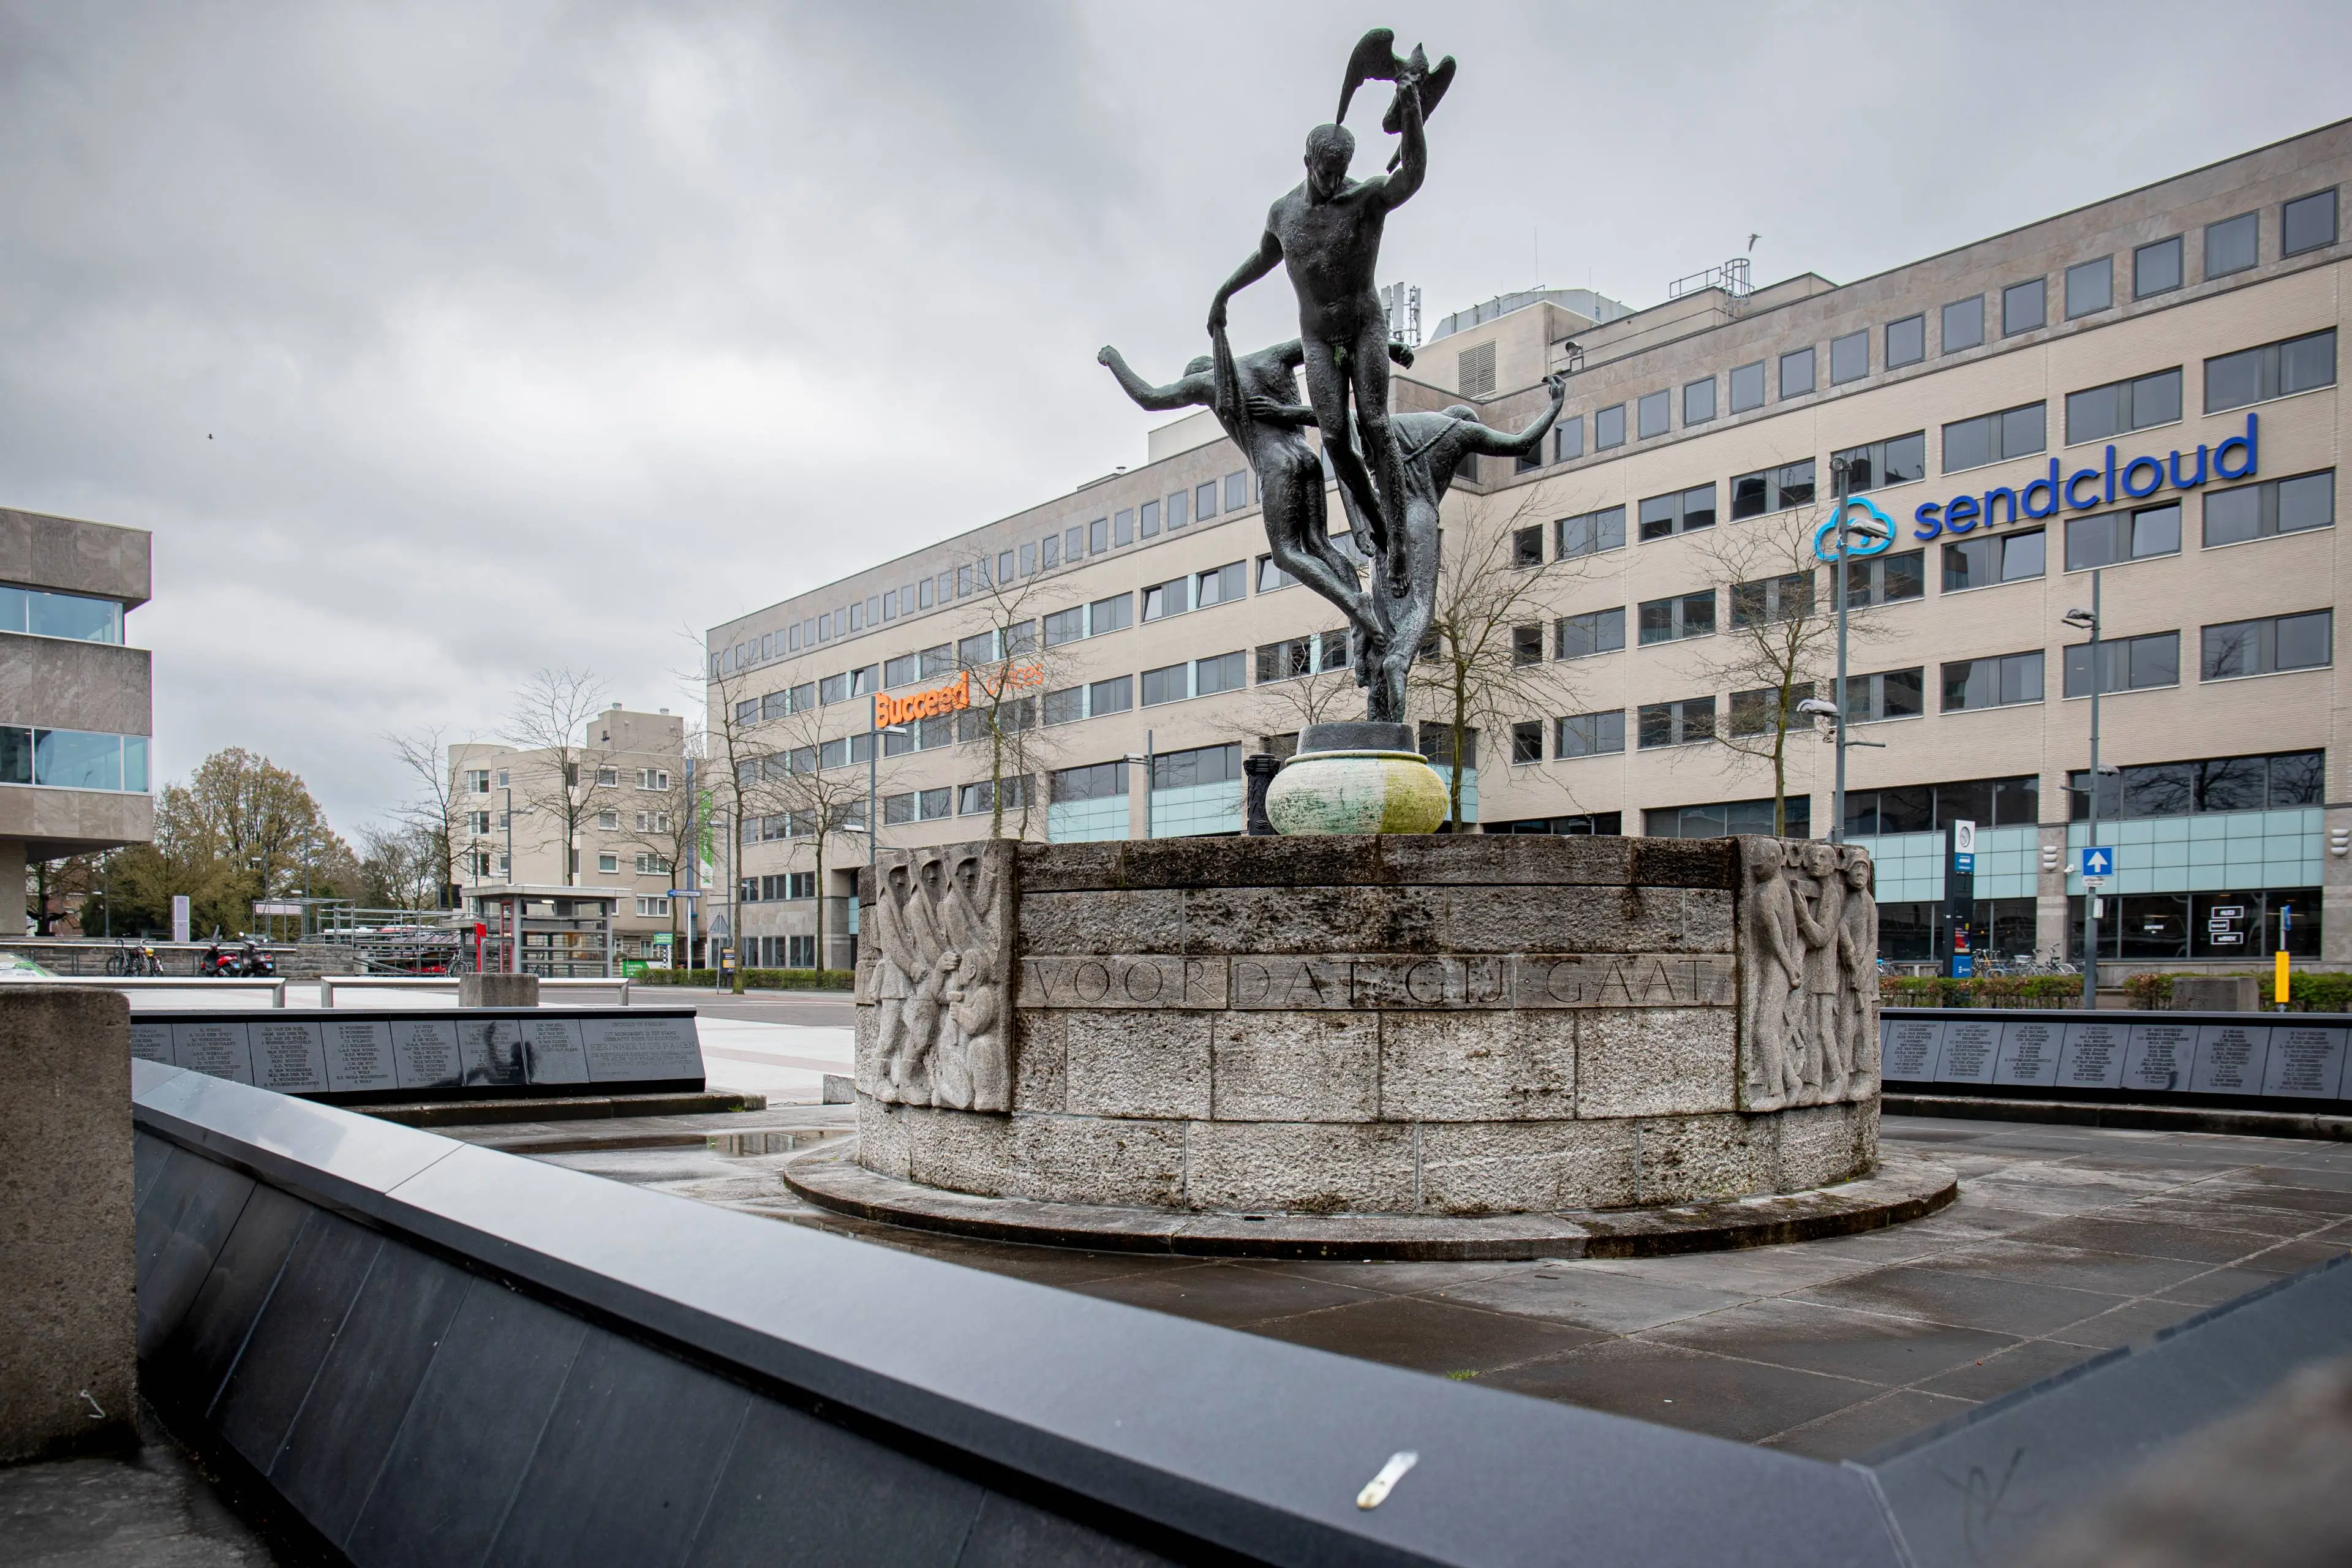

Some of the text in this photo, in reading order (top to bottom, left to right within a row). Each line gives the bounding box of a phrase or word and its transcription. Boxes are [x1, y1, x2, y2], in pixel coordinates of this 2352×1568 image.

[1914, 413, 2258, 540] sendcloud
[876, 671, 970, 728] Succeed
[1406, 960, 1508, 1005] GIJ
[1547, 960, 1712, 1002] GAAT
